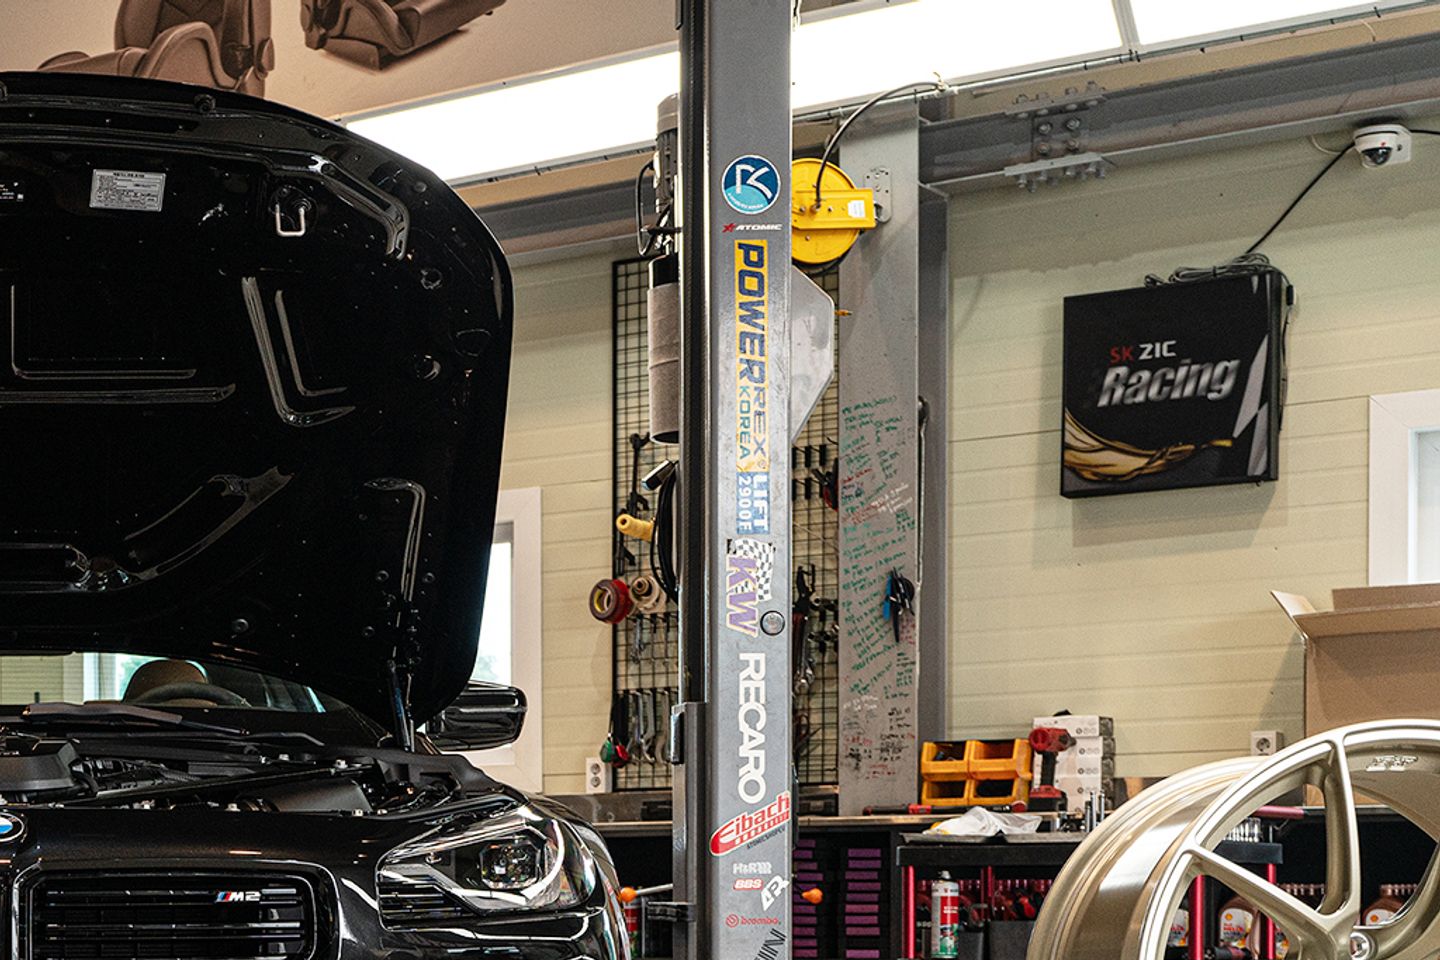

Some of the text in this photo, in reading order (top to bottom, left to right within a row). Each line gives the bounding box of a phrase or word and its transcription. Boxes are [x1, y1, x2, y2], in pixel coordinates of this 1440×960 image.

[1110, 340, 1177, 364] SK ZIC
[1097, 359, 1241, 408] Racing
[739, 386, 752, 460] KOREA
[753, 474, 768, 531] LIFT
[727, 555, 758, 637] KW
[738, 652, 767, 804] RECARO
[711, 791, 791, 854] Eibach
[230, 891, 261, 902] M2
[734, 878, 763, 889] BBS
[741, 915, 779, 926] brembo
